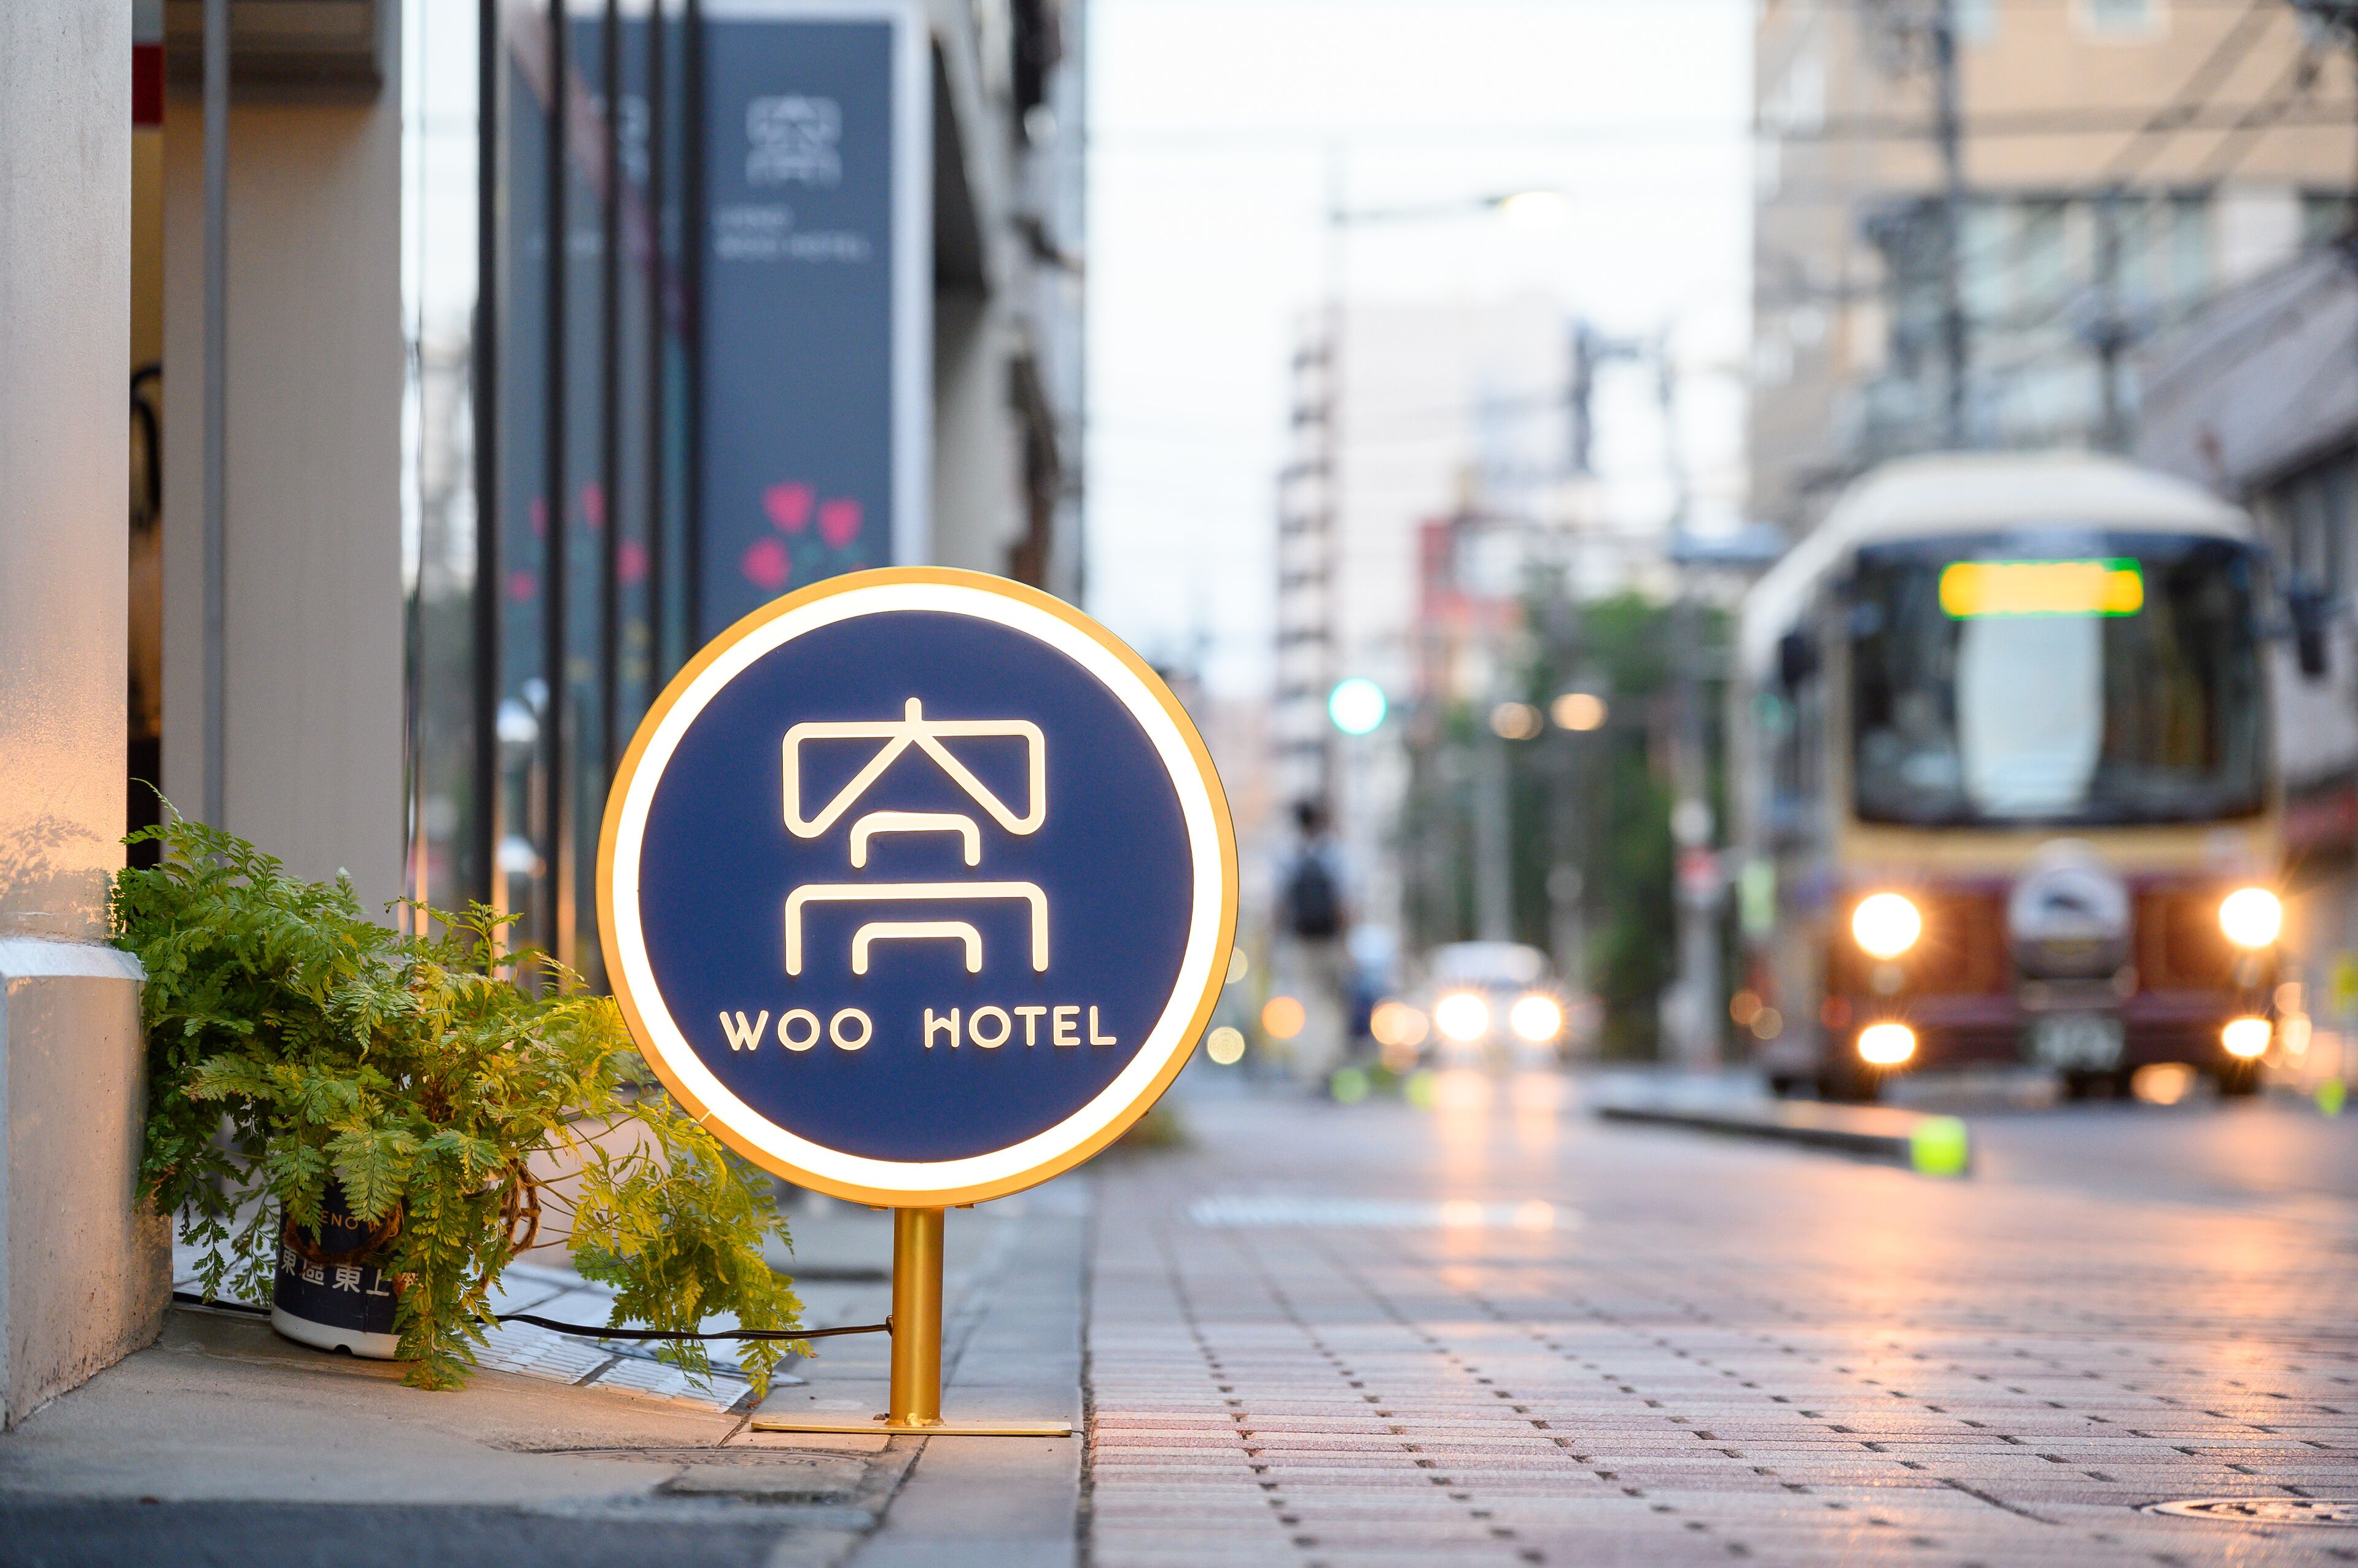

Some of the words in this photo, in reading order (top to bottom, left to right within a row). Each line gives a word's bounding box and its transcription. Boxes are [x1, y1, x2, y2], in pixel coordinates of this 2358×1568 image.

[719, 1007, 873, 1051] WOO
[924, 1005, 1117, 1049] HOTEL
[319, 1209, 359, 1230] ENO
